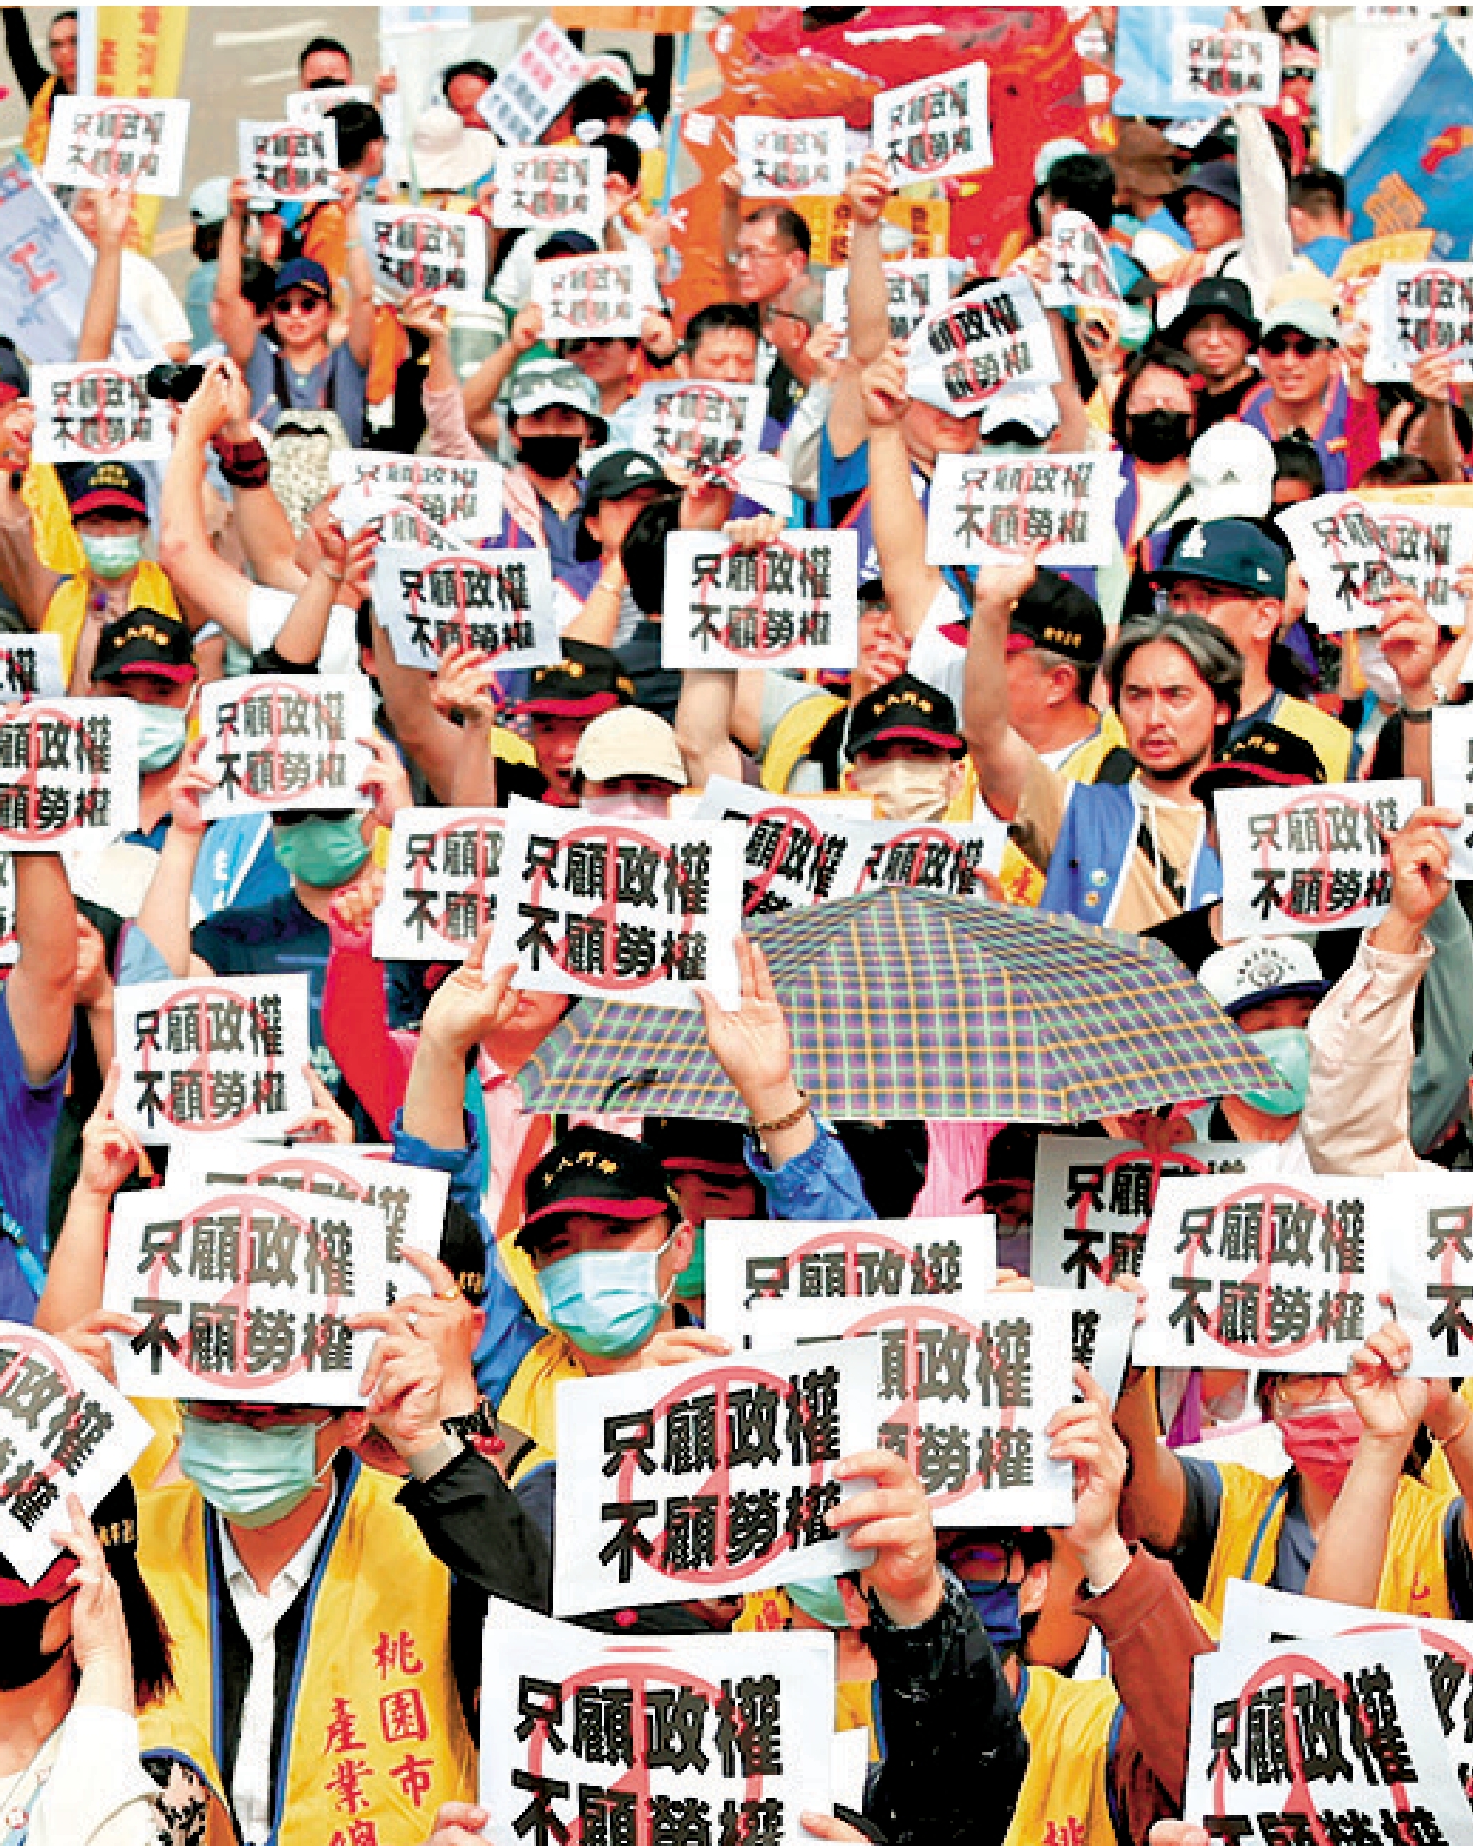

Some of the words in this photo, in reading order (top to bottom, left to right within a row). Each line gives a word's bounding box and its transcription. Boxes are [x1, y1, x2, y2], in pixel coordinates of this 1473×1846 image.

[958, 461, 1093, 499] 只顧政權
[955, 503, 1087, 550] 不顧勞權
[399, 559, 530, 611] 只顧政權
[689, 548, 832, 598] 只顧政權
[689, 601, 830, 652] 不顧勞權
[215, 693, 347, 739] 只顧政權
[215, 749, 345, 800] 不顧勞權
[1249, 799, 1396, 855] 只顧政權
[523, 838, 713, 915] 只顧政權
[1250, 867, 1393, 922] 不顧勞權
[517, 904, 708, 980] 不顧勞權
[135, 995, 286, 1058] 只顧政權
[135, 1068, 288, 1131] 不顧勞權
[138, 1214, 357, 1296] 只顧政權
[1177, 1198, 1366, 1273] 只顧政權
[132, 1296, 354, 1376] 不顧勞權
[1167, 1276, 1366, 1346] 不顧勞權
[600, 1366, 841, 1479] 只顧政權
[597, 1479, 843, 1585] 不顧勞權
[372, 1629, 438, 1809] 桃園市
[514, 1675, 784, 1778] 只顧政權
[1205, 1664, 1417, 1788] 只顧政權
